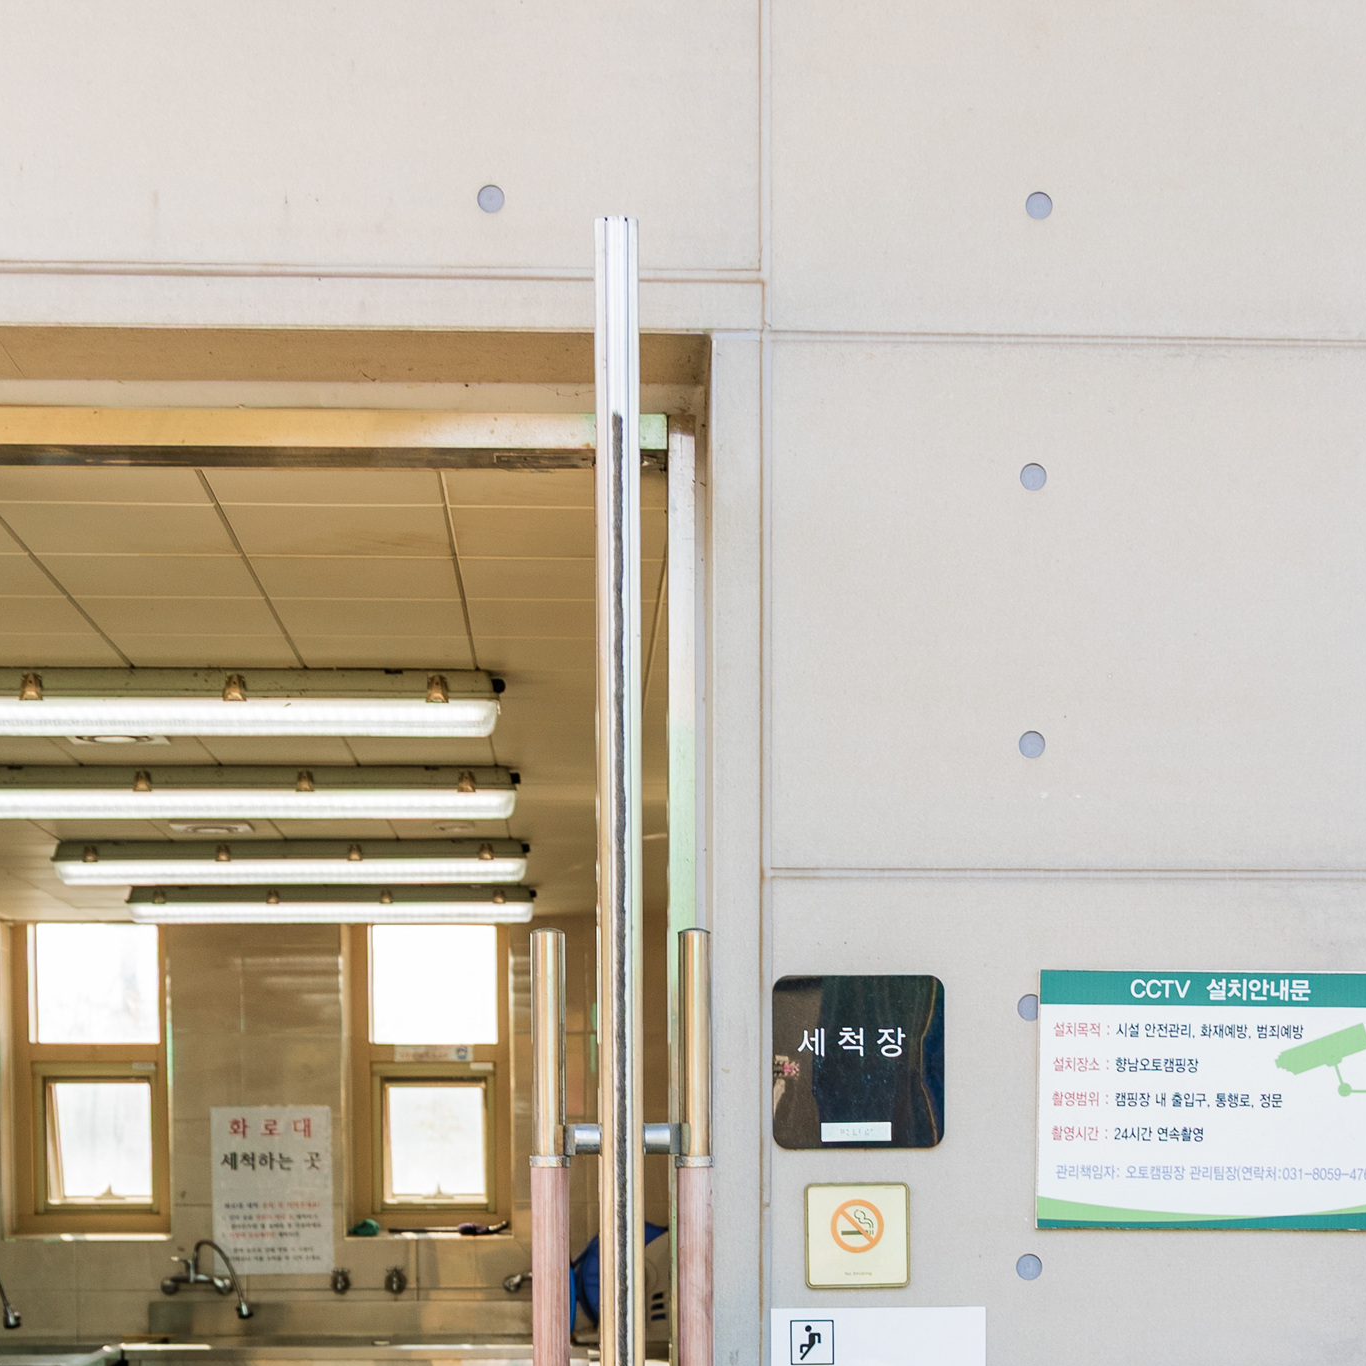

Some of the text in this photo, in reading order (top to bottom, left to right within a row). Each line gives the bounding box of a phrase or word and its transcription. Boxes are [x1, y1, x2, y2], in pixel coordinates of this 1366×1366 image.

[1130, 978, 1311, 1001] CCTV 설치안내문
[1053, 1022, 1101, 1038] 설치목적
[1115, 1023, 1140, 1038] 시설
[1144, 1023, 1196, 1039] 안전관리,
[1200, 1023, 1251, 1040] 화재예방,
[1256, 1024, 1304, 1040] 범죄예방
[1052, 1056, 1100, 1072] 설치장소
[1115, 1057, 1199, 1073] 향남오토캠핑장
[1051, 1090, 1100, 1107] 촬영범위
[1115, 1092, 1151, 1107] 캠핑장
[1155, 1092, 1167, 1107] 내
[1171, 1092, 1210, 1108] 출입구,
[1215, 1092, 1254, 1109] 통행로,
[1259, 1093, 1283, 1109] 정문
[1051, 1125, 1099, 1141] 촬영시간
[1114, 1126, 1153, 1142] 24시간
[1157, 1126, 1204, 1142] 연속촬영
[220, 1151, 321, 1171] 세척하는 곳
[1055, 1164, 1120, 1180] 관리책임자:
[1125, 1164, 1186, 1181] 오토캠핑장
